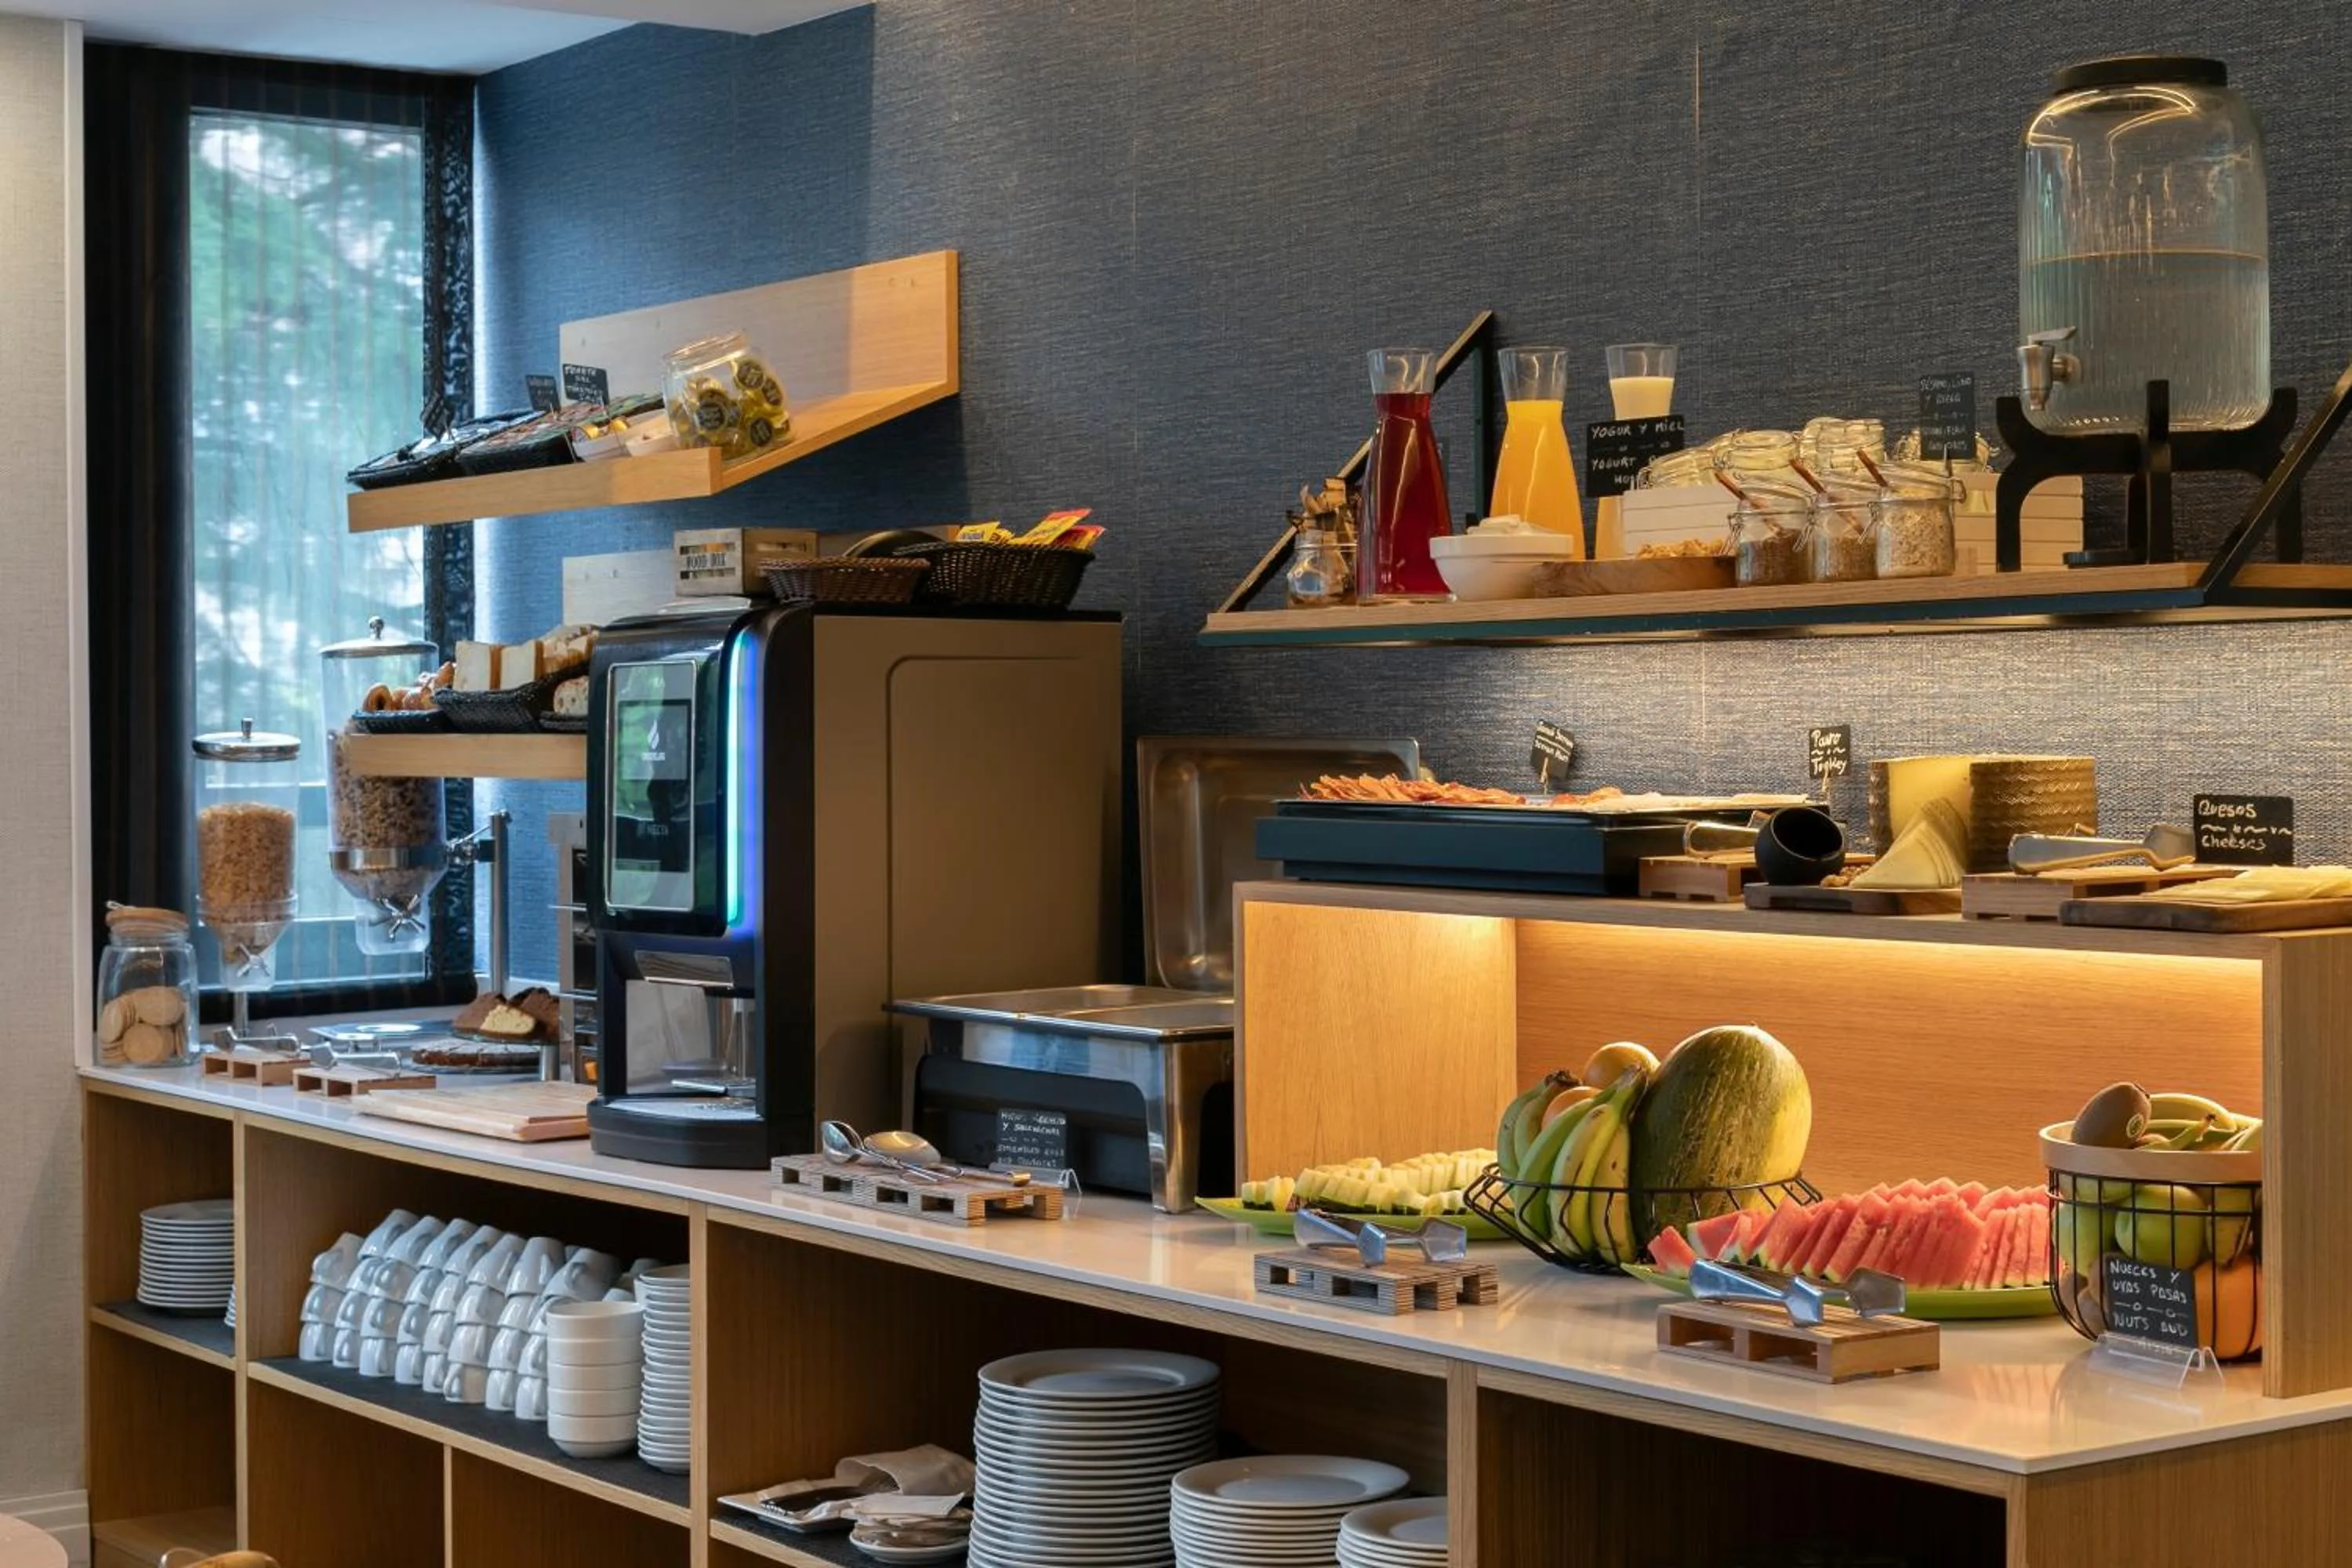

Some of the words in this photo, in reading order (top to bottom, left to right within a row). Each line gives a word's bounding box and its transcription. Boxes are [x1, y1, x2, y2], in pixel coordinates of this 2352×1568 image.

[1591, 424, 1632, 440] YOGUR
[1639, 423, 1648, 434] Y
[1591, 456, 1638, 471] YOGURT
[2110, 1260, 2157, 1279] NUECES
[2170, 1272, 2180, 1283] Y
[2112, 1312, 2150, 1330] NUTS
